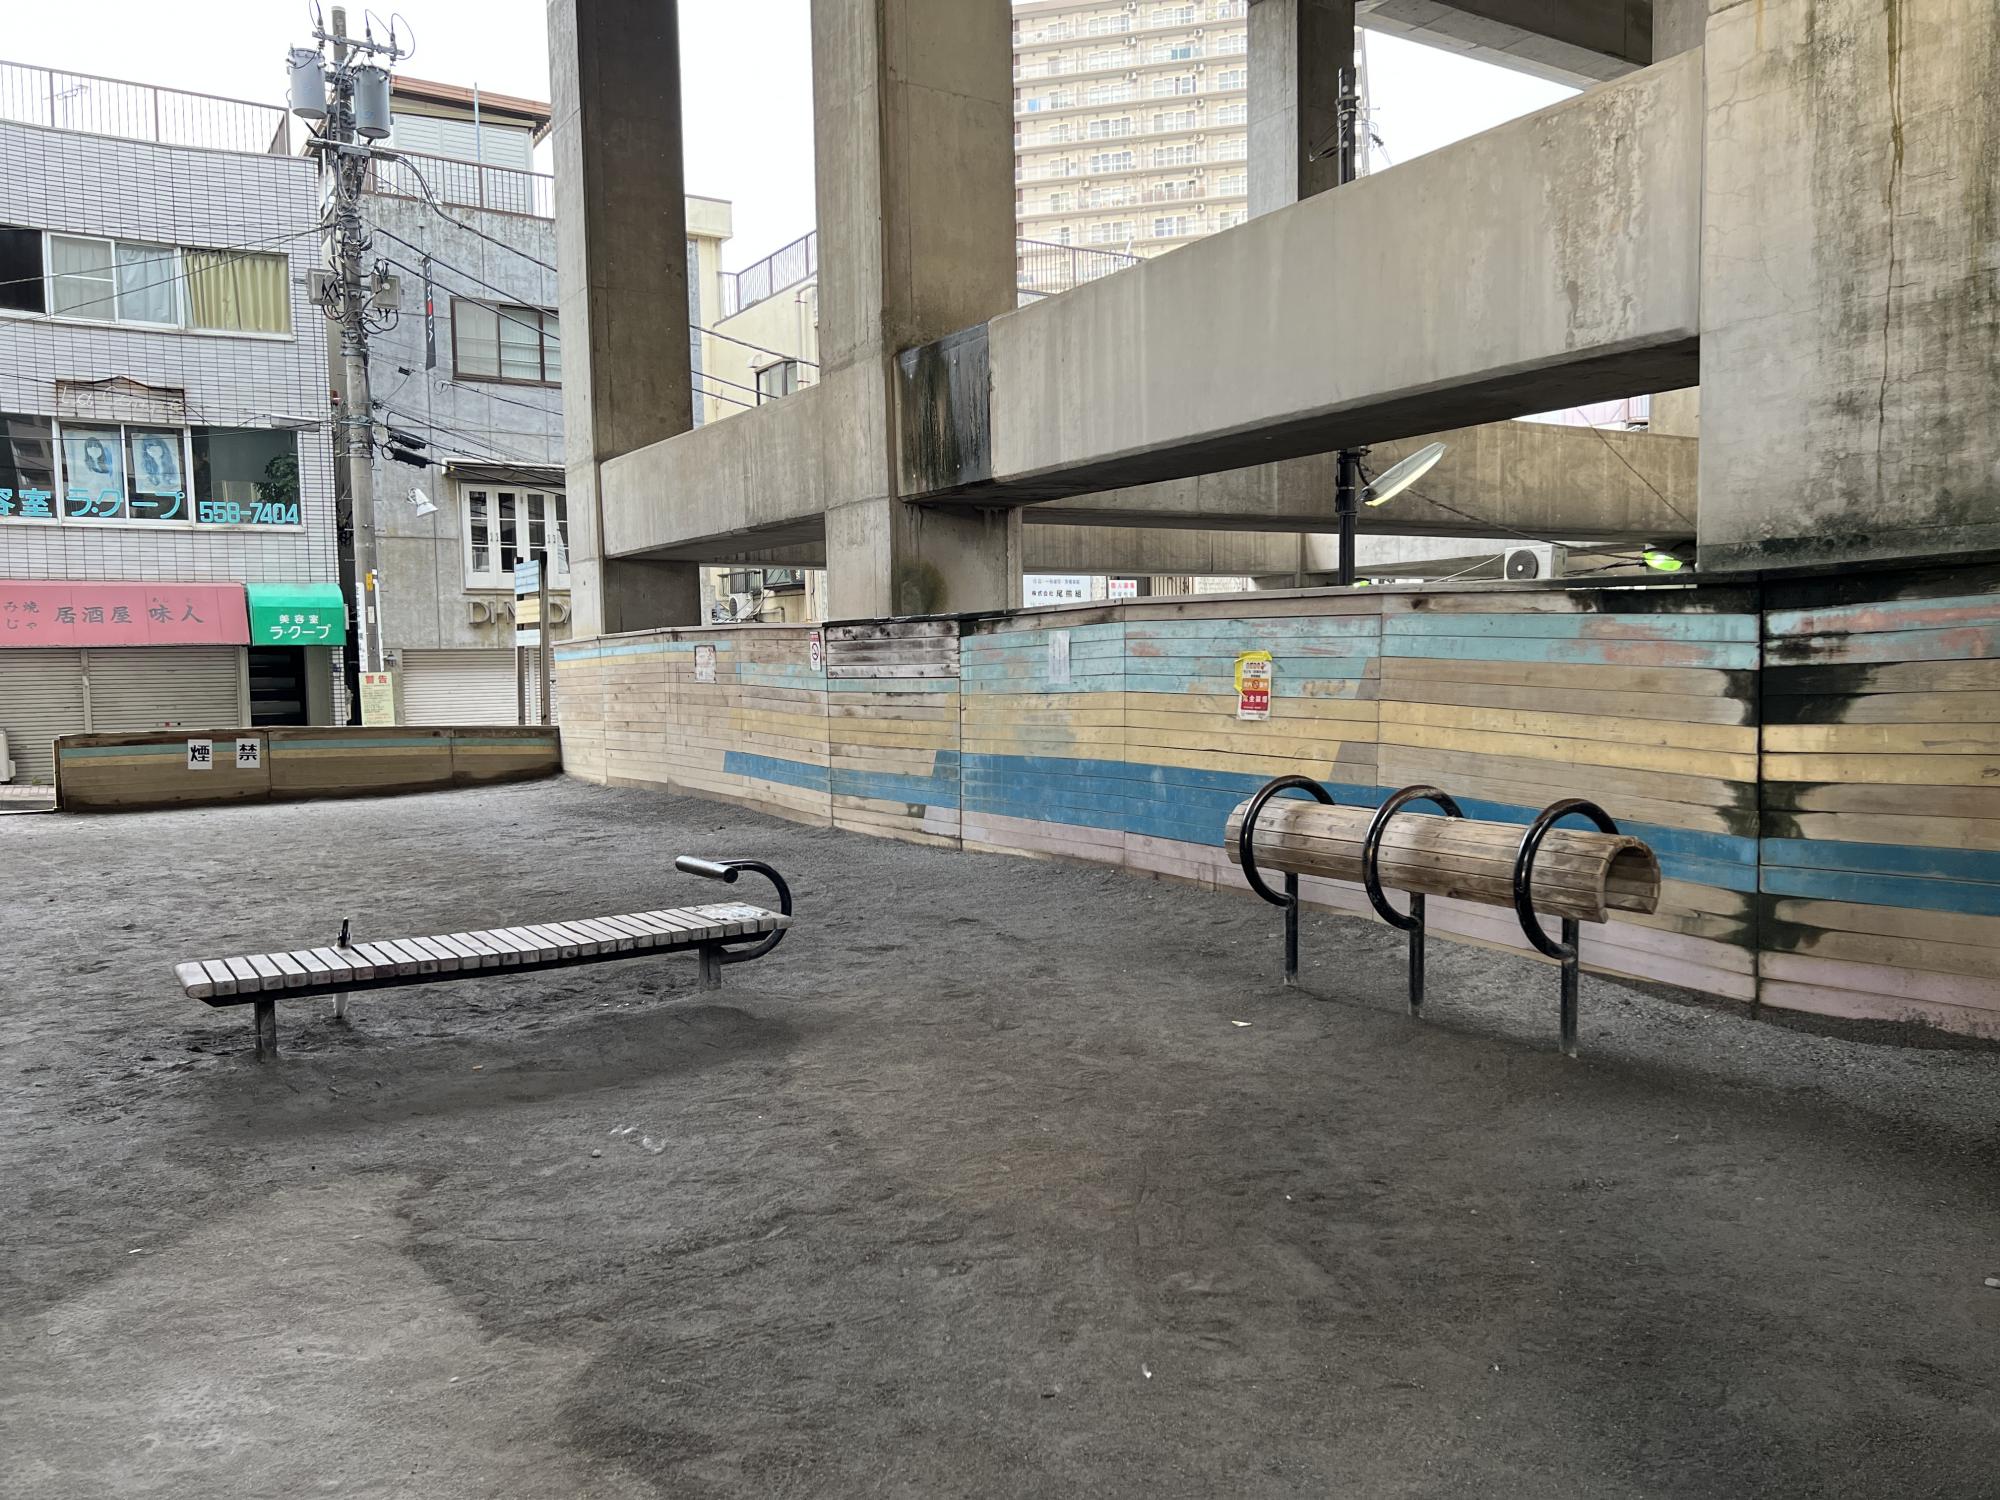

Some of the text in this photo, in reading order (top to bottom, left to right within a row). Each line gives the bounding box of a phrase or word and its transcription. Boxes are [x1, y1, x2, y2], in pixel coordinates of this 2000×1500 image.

[199, 501, 299, 525] 558-7404
[53, 603, 204, 624] 居酒屋 味人
[279, 614, 319, 624] 美容室
[269, 623, 331, 639] ラ・クープ
[190, 743, 258, 762] 煙 禁
